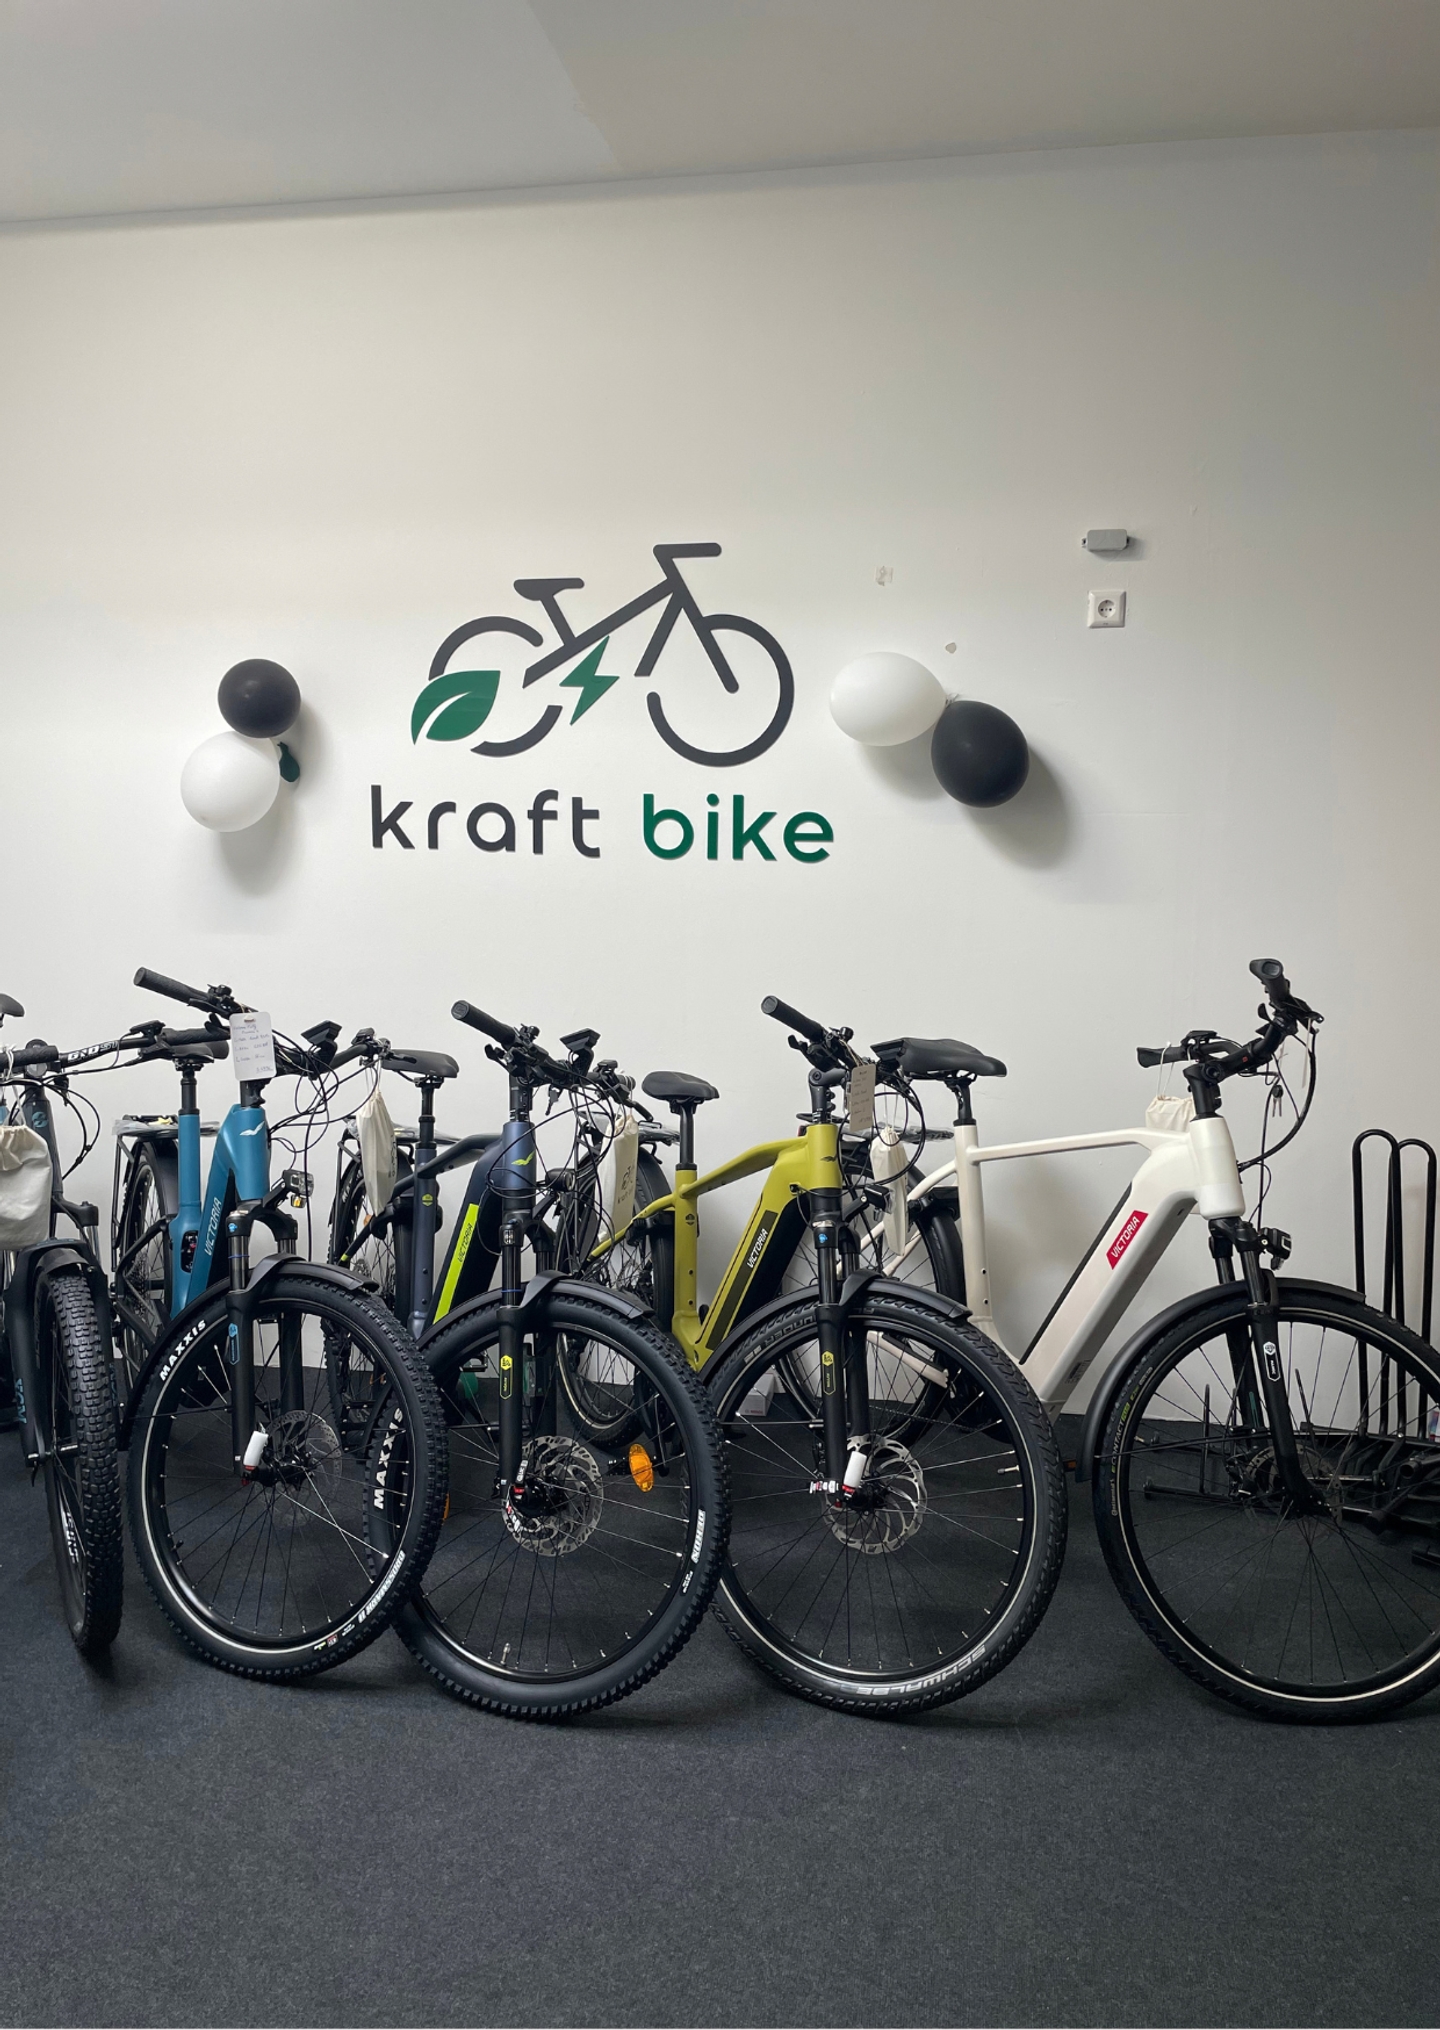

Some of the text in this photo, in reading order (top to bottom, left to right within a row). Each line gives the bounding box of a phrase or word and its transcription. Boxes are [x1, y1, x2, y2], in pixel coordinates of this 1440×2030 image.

[371, 785, 834, 863] kraft bike
[204, 1196, 222, 1256] VICTORIA
[457, 1222, 473, 1263] VICTORIA
[746, 1228, 769, 1269] VICTORIA
[1110, 1216, 1141, 1258] VICTORIA
[160, 1319, 206, 1381] MAXXIS
[374, 1408, 403, 1510] MAXXIS
[856, 1644, 986, 1696] SCHWALBE
